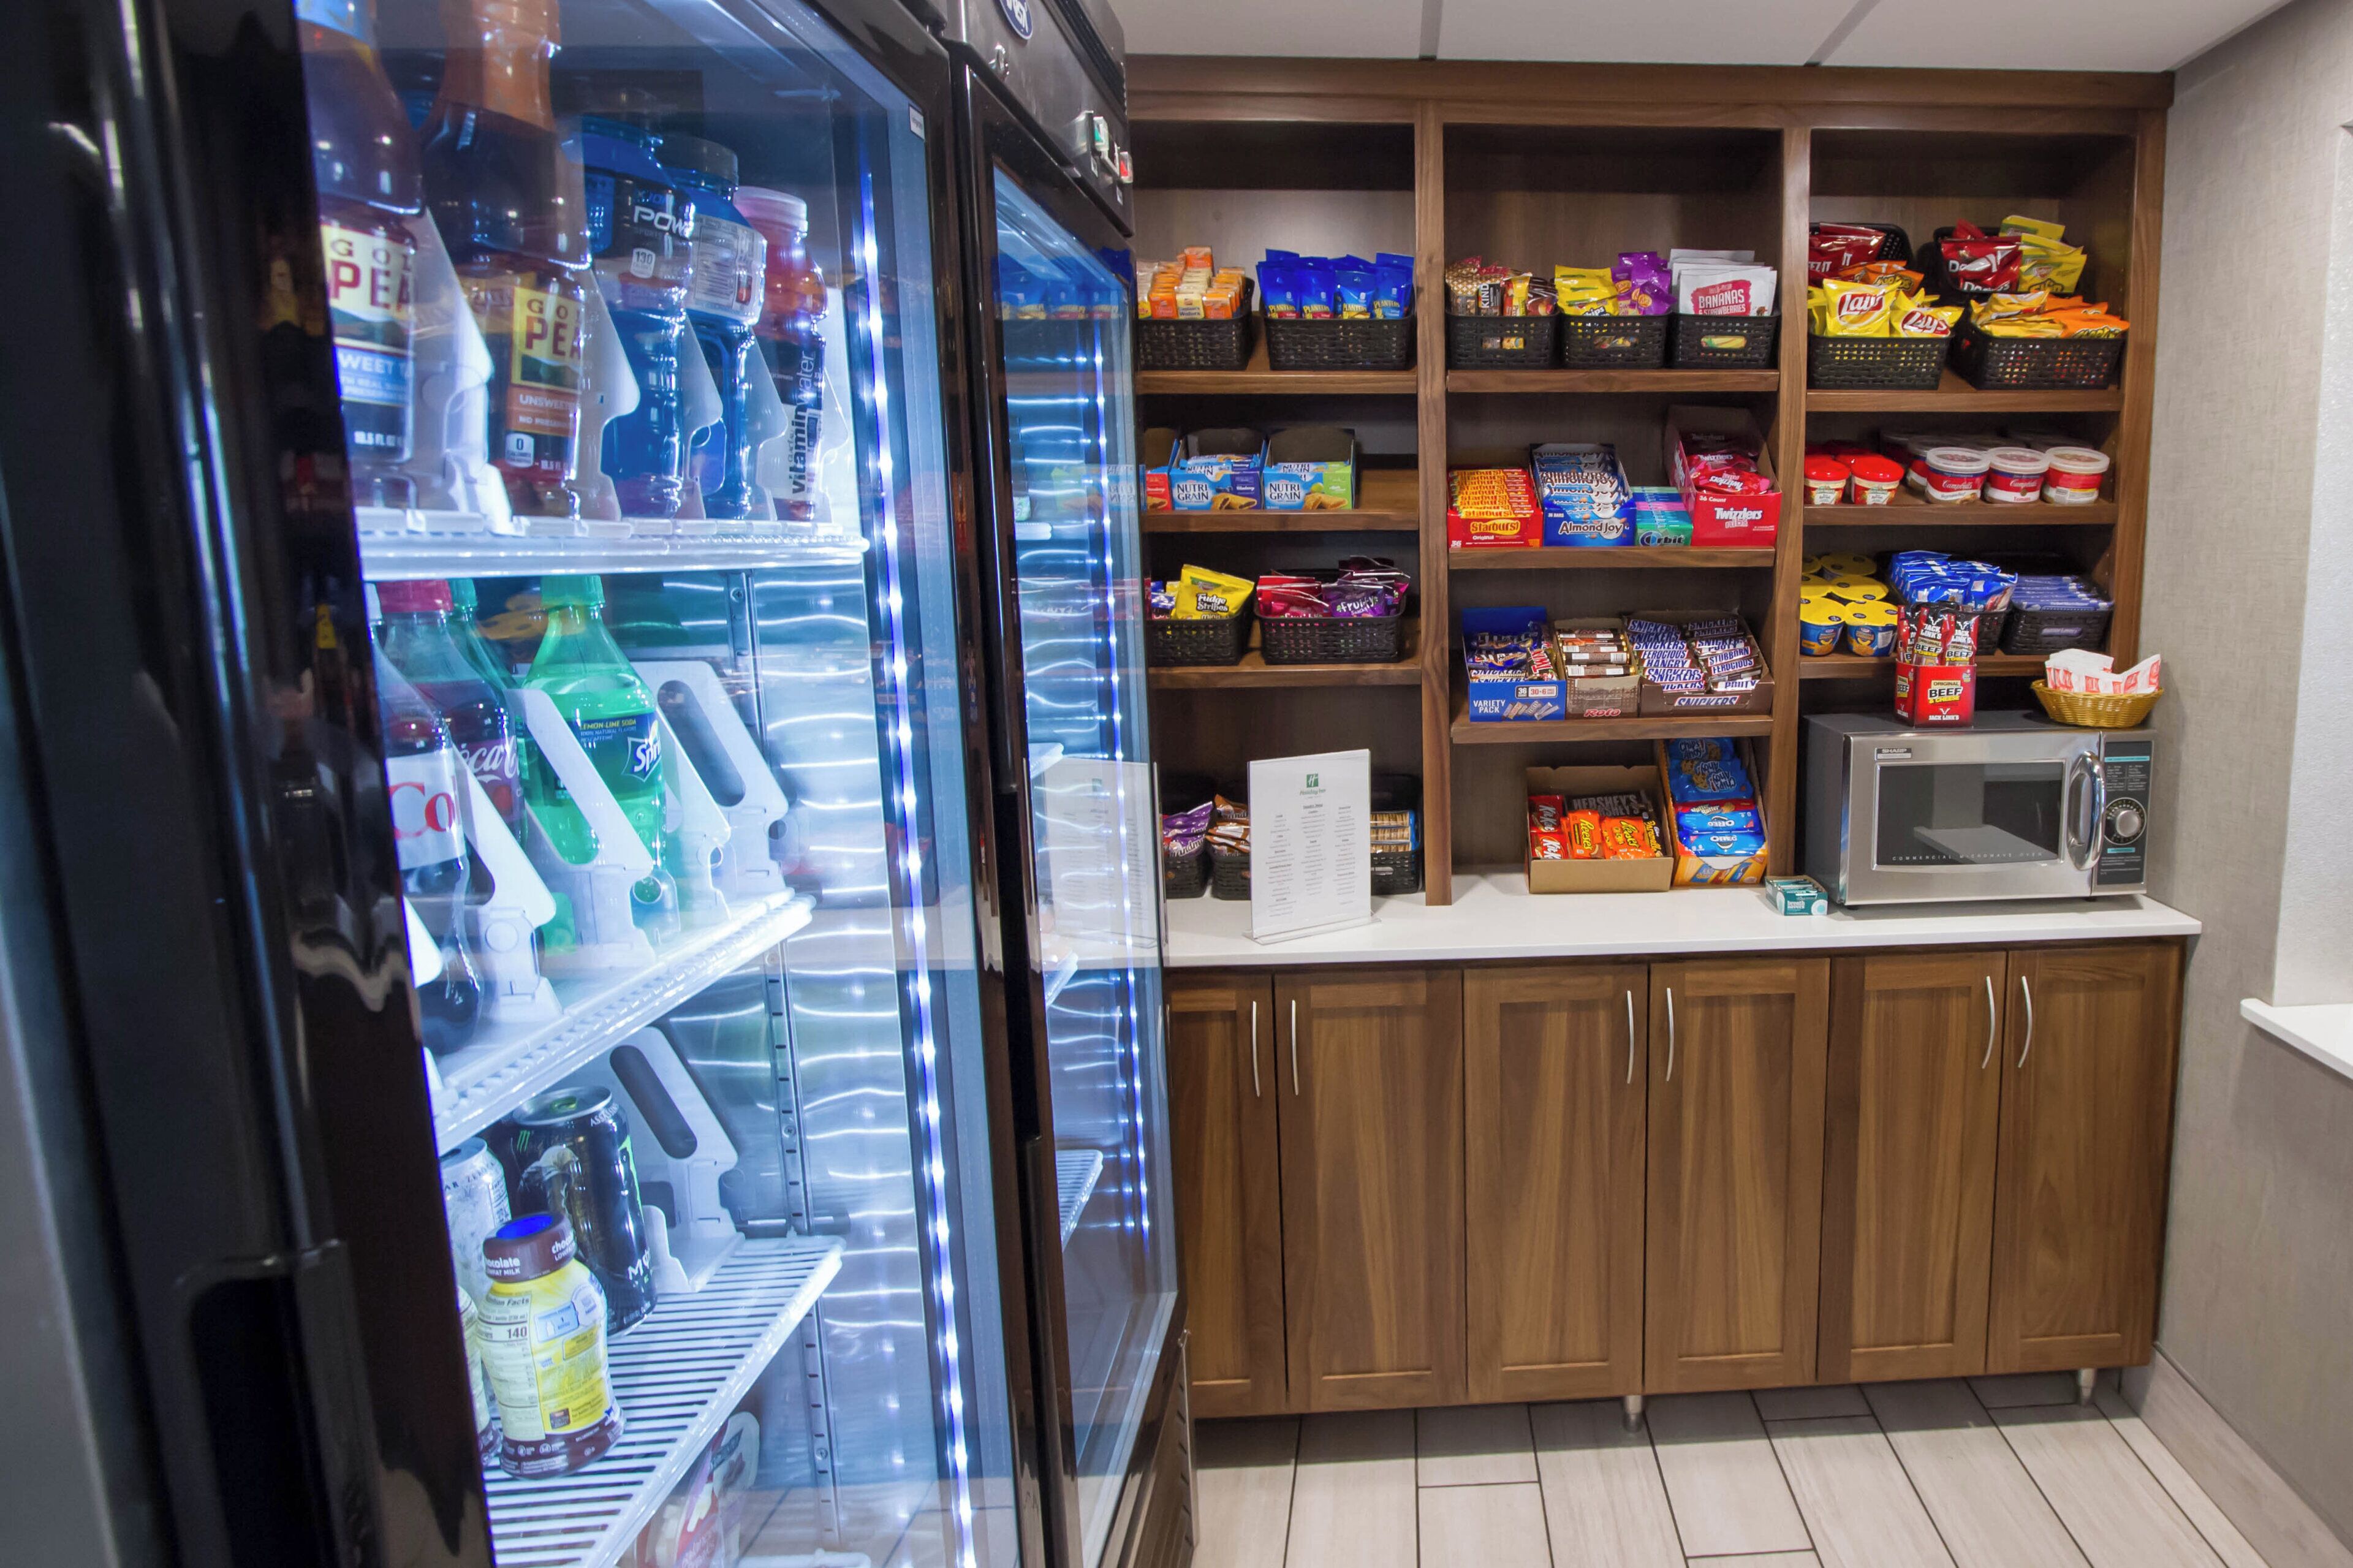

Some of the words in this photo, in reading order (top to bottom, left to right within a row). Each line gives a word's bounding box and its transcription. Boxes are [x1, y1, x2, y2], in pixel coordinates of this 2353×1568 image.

[635, 251, 653, 265] 130
[1482, 284, 1490, 308] KIND
[1699, 289, 1745, 308] BANANAS
[1703, 304, 1746, 315] STRAWBERRIES
[517, 438, 524, 450] 0
[1177, 483, 1208, 494] NUTRI
[1270, 483, 1300, 493] NUTRI
[1709, 475, 1743, 491] Twizzlers
[1178, 492, 1208, 501] GRAIN
[1270, 491, 1301, 501] GRAIN
[1714, 507, 1763, 521] Twizzlers
[1471, 521, 1520, 534] Starburst
[1559, 521, 1602, 535] Almond
[1603, 521, 1623, 534] Joy
[1640, 531, 1684, 546] Orbit
[1197, 593, 1227, 605] Fudge
[1197, 601, 1229, 612] Stripes
[1630, 619, 1679, 632] SNICKERS
[1924, 624, 1941, 632] JACK
[1635, 641, 1686, 650] SNICKERS
[1915, 643, 1942, 653] BEEF
[1642, 650, 1686, 659] FEROCIOUS
[1709, 647, 1749, 665] STUBBORN
[1646, 659, 1687, 668] HANGRY
[1713, 659, 1754, 675] FEROCIOUS
[1650, 673, 1703, 682] SNICKERS
[1928, 687, 1963, 699] BEEF
[1473, 699, 1506, 708] VARIETY
[1677, 696, 1738, 706] SNICKERS
[1583, 708, 1621, 718] Rolo
[1702, 806, 1721, 816] Butter
[1708, 819, 1735, 828] OREO
[506, 1297, 530, 1306] Facts
[507, 1327, 528, 1339] 140
